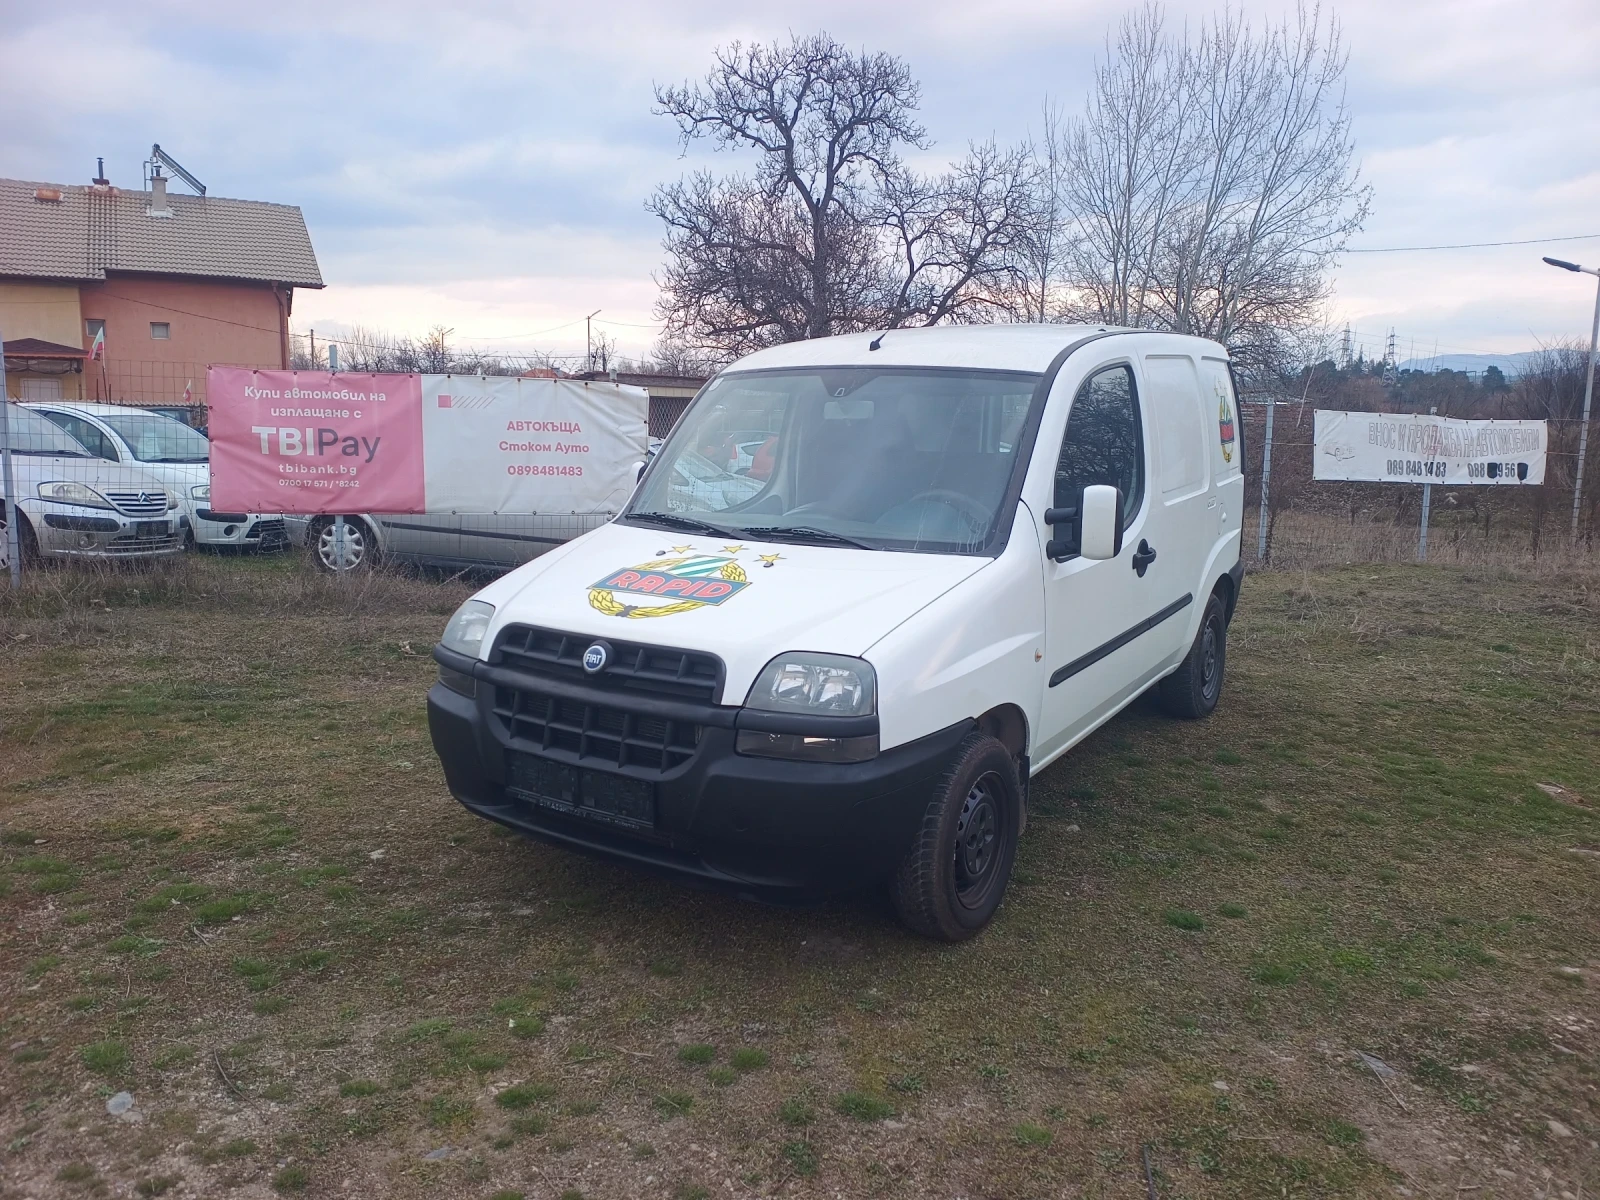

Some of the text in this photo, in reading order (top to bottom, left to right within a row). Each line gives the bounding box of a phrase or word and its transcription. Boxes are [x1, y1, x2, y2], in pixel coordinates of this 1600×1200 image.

[244, 385, 386, 402] Купи автомобил на
[270, 407, 362, 419] изплащане с
[507, 421, 581, 434] АВТОКЪЩА
[251, 425, 381, 464] TBIPay
[1369, 423, 1396, 449] ВНОС
[1398, 424, 1406, 451] И
[499, 440, 590, 455] Стоком Ауто
[278, 464, 357, 476] tbibank.bg
[507, 465, 583, 477] 0898481483
[1387, 459, 1404, 476] 089
[1405, 460, 1423, 477] 848
[1435, 461, 1447, 478] 83
[1467, 462, 1485, 478] 088
[278, 479, 302, 487] 0700
[303, 479, 313, 487] 17
[314, 480, 328, 488] 571
[608, 570, 733, 598] RAPID
[585, 653, 602, 665] FIAT
